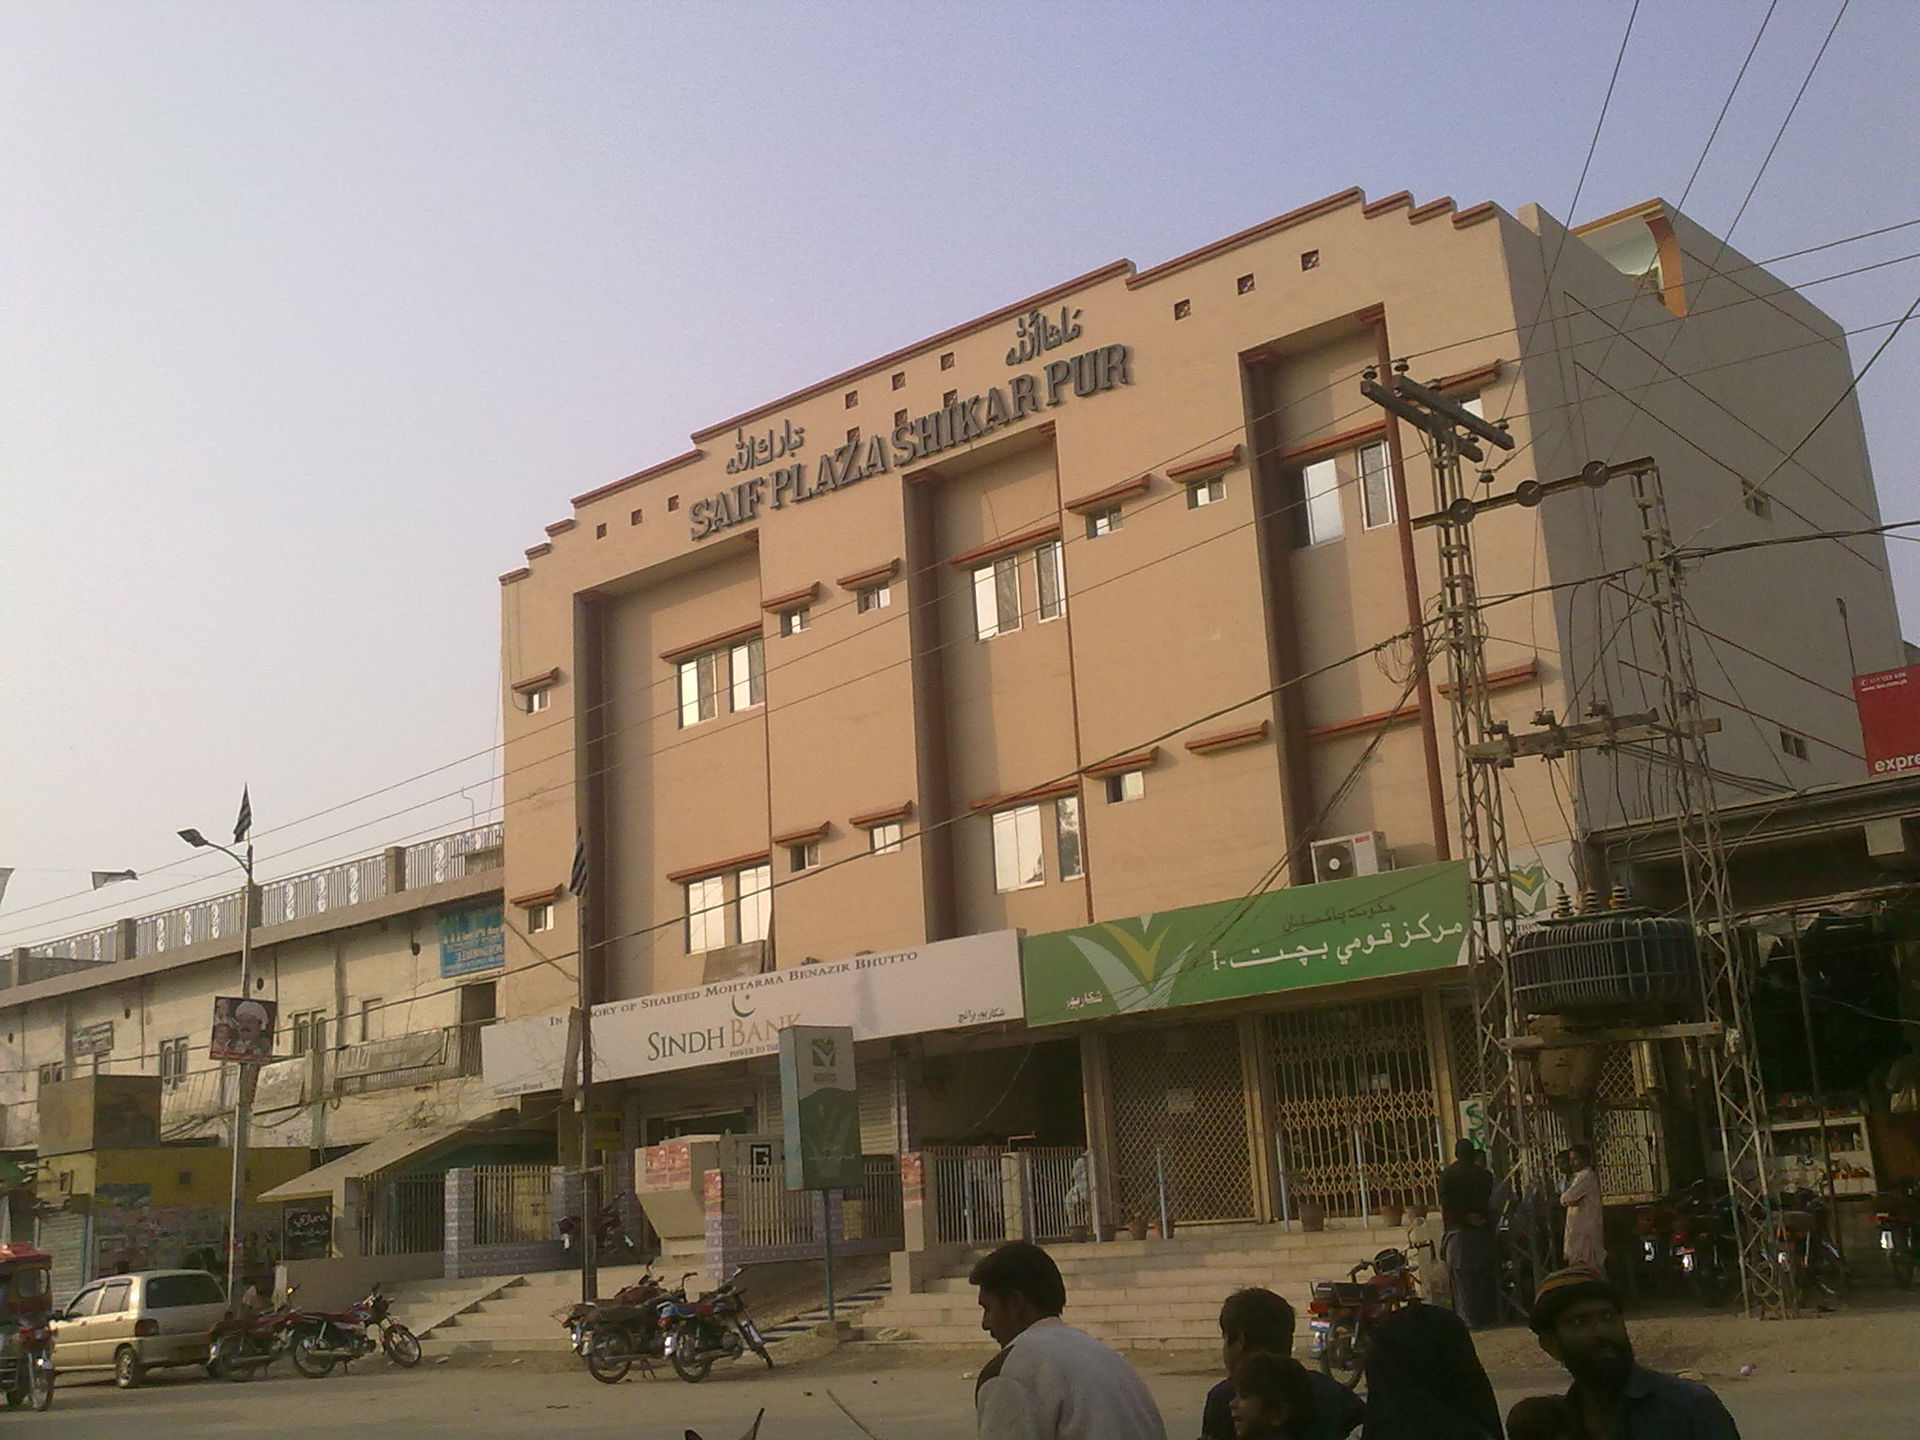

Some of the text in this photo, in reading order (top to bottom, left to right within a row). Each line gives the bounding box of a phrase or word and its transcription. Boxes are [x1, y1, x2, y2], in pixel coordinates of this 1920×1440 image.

[691, 477, 764, 541] SAIF
[769, 435, 888, 509] PLAZA
[855, 951, 918, 970] BHUTTO
